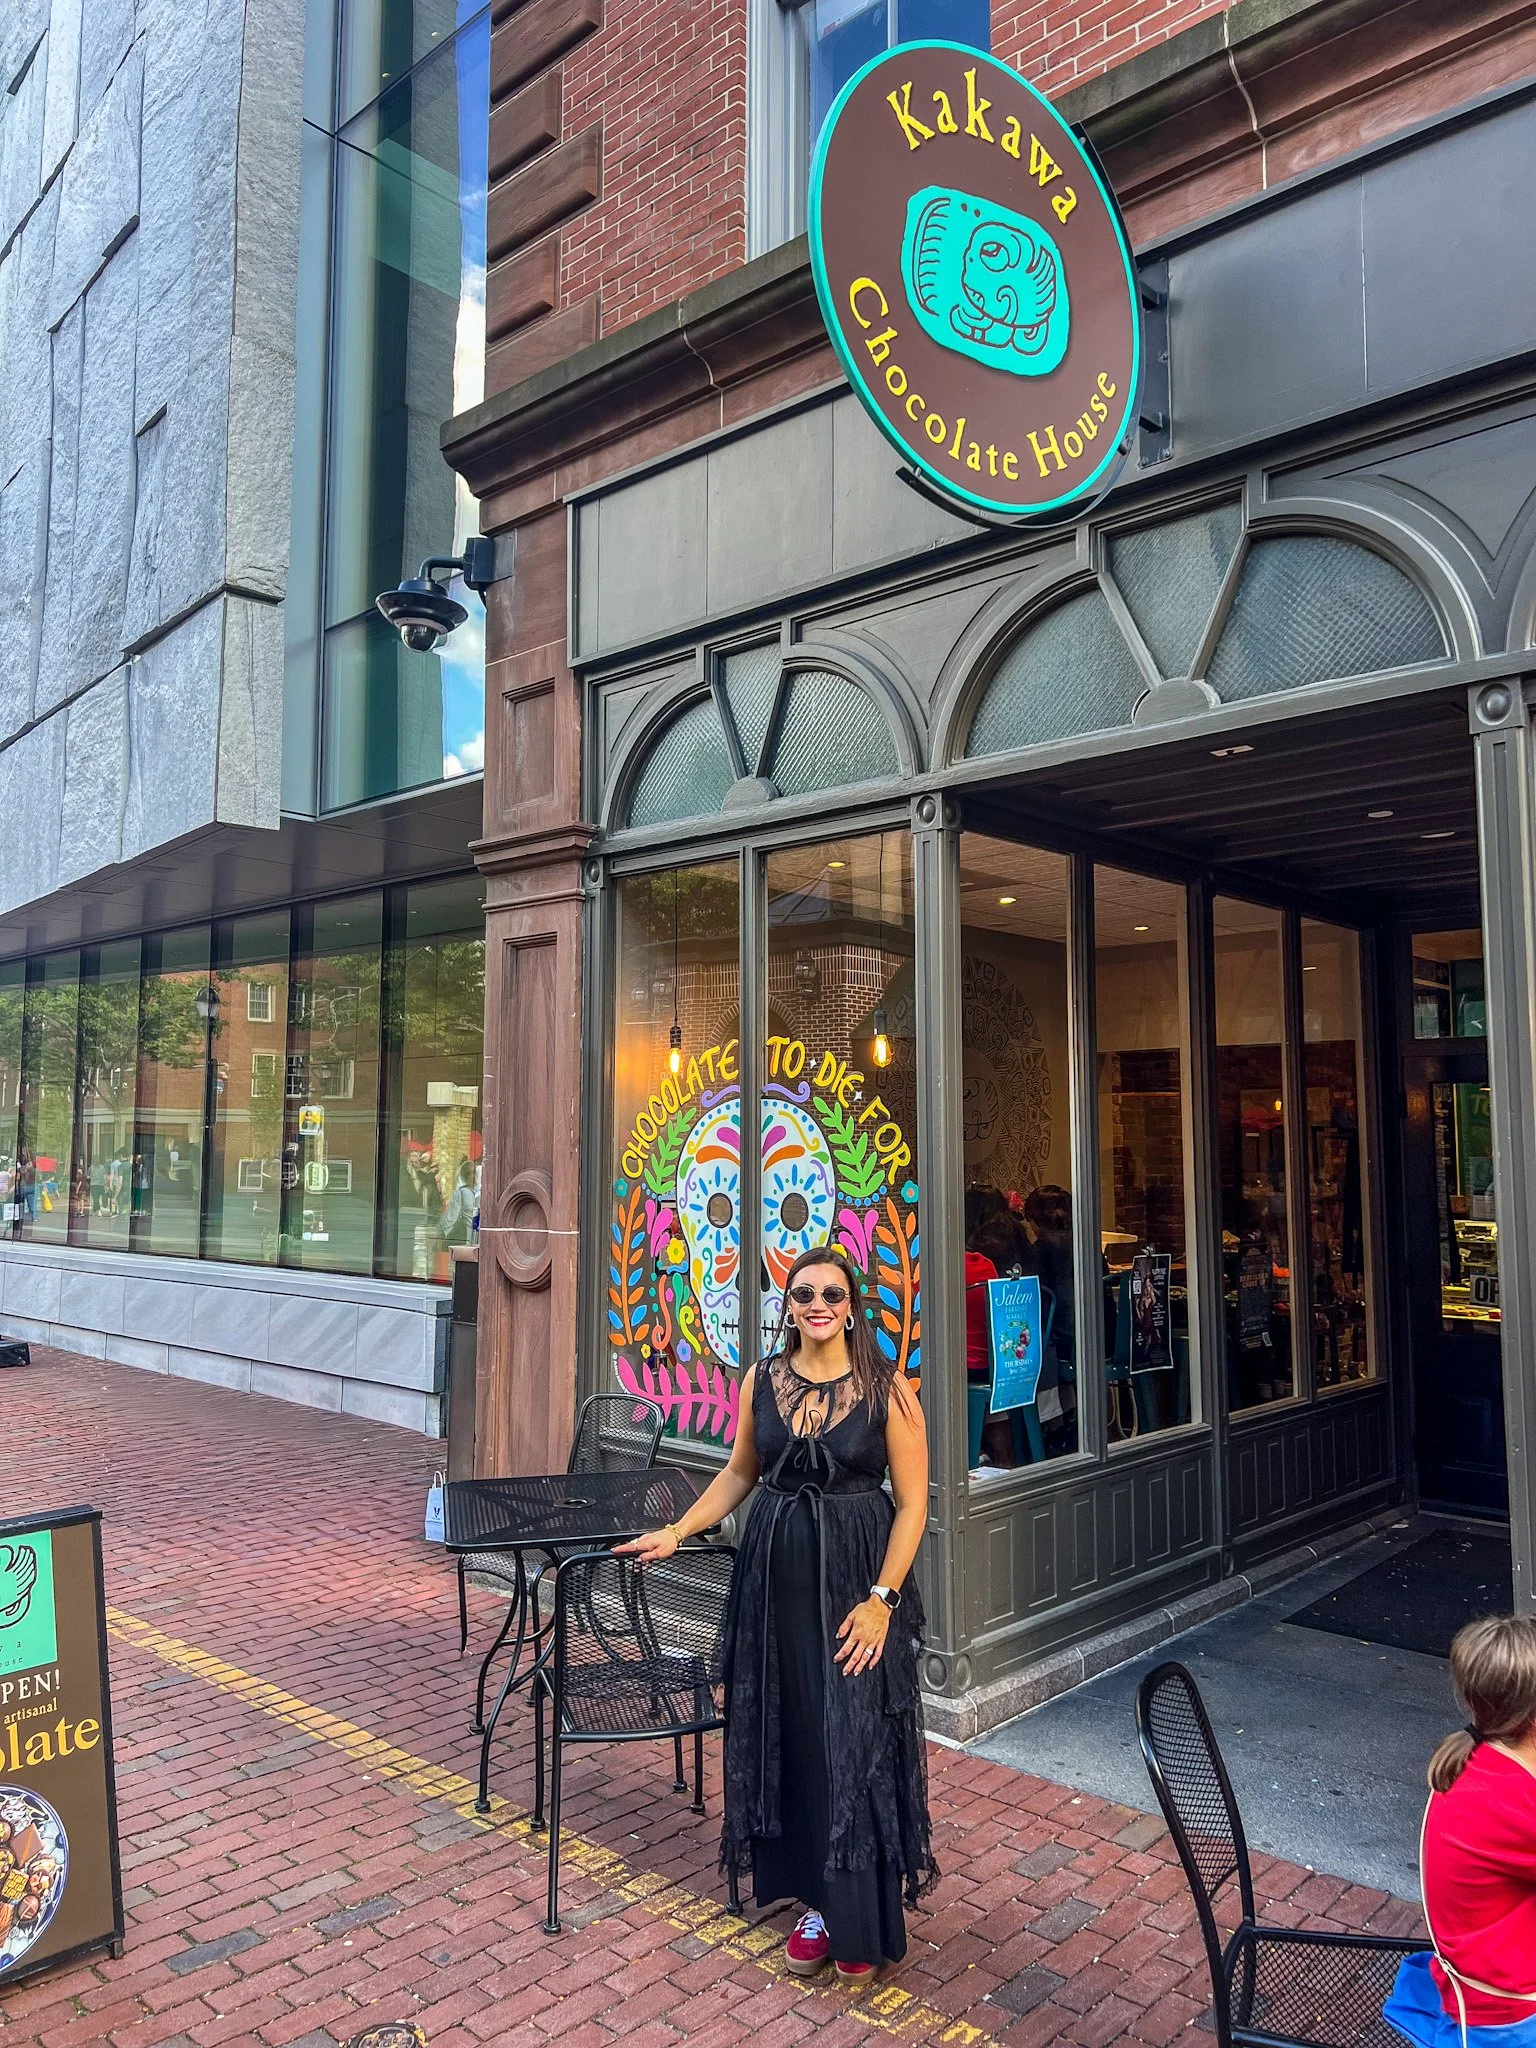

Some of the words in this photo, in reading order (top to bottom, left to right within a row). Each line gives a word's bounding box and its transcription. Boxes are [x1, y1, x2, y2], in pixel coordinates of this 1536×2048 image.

[886, 67, 1078, 224] Kakawa
[849, 276, 1019, 480] Chocolate
[1027, 371, 1117, 478] House
[621, 1038, 740, 1179] CHOCOLATE
[766, 1035, 806, 1079] TO
[813, 1050, 865, 1108] DIE
[858, 1096, 912, 1185] FOR
[995, 1283, 1033, 1307] Salem
[0, 1716, 100, 1772] late
[3, 1696, 58, 1725] artisanal
